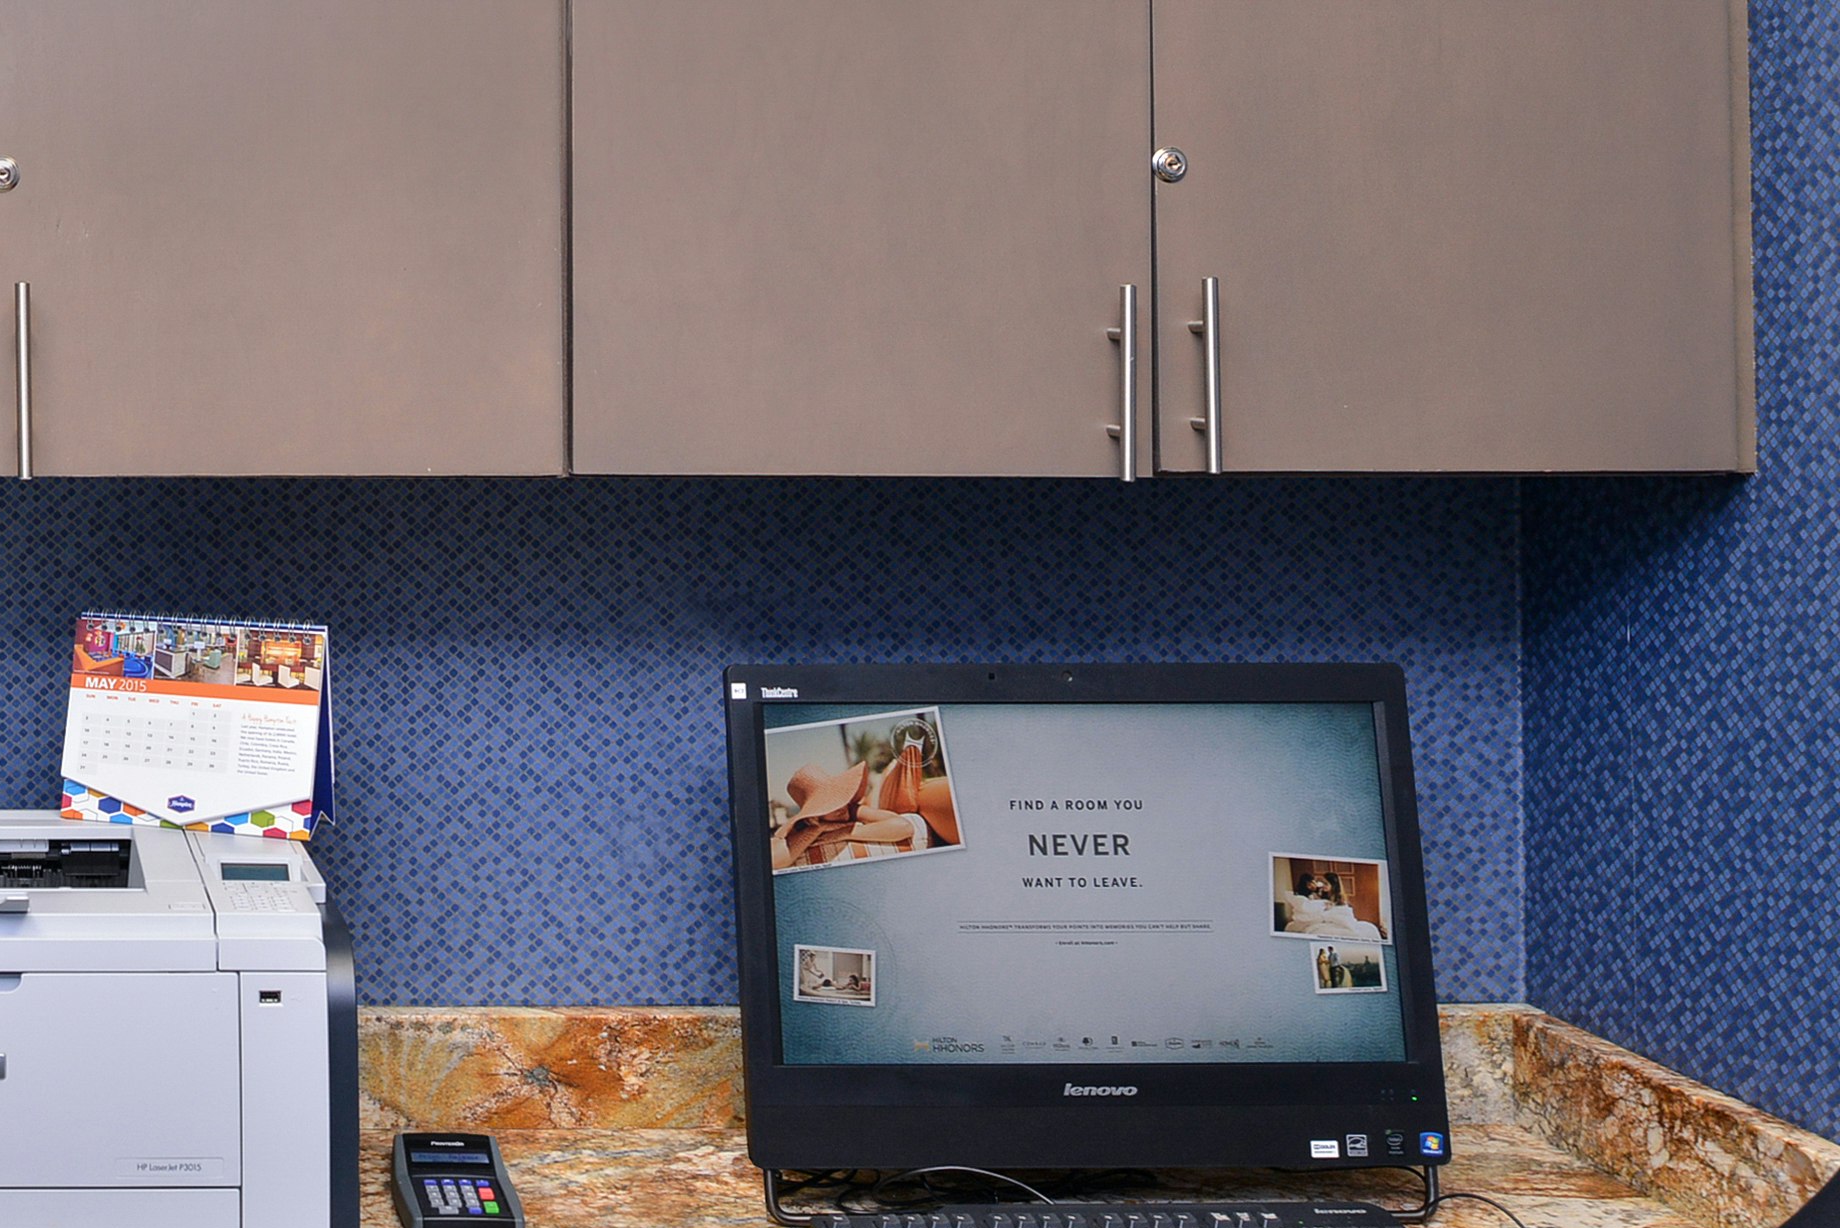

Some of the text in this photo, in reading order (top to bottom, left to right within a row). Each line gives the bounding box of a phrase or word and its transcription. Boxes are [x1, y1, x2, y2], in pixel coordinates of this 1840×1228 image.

[85, 677, 147, 692] MAY 2015
[1009, 799, 1143, 810] FIND A ROOM YOU
[1028, 833, 1131, 856] NEVER
[1022, 877, 1143, 888] WANT TO LEAVE.
[933, 1043, 985, 1053] HHONORS
[1063, 1083, 1138, 1096] lenovo
[136, 1163, 202, 1172] HP LaserJet P3015
